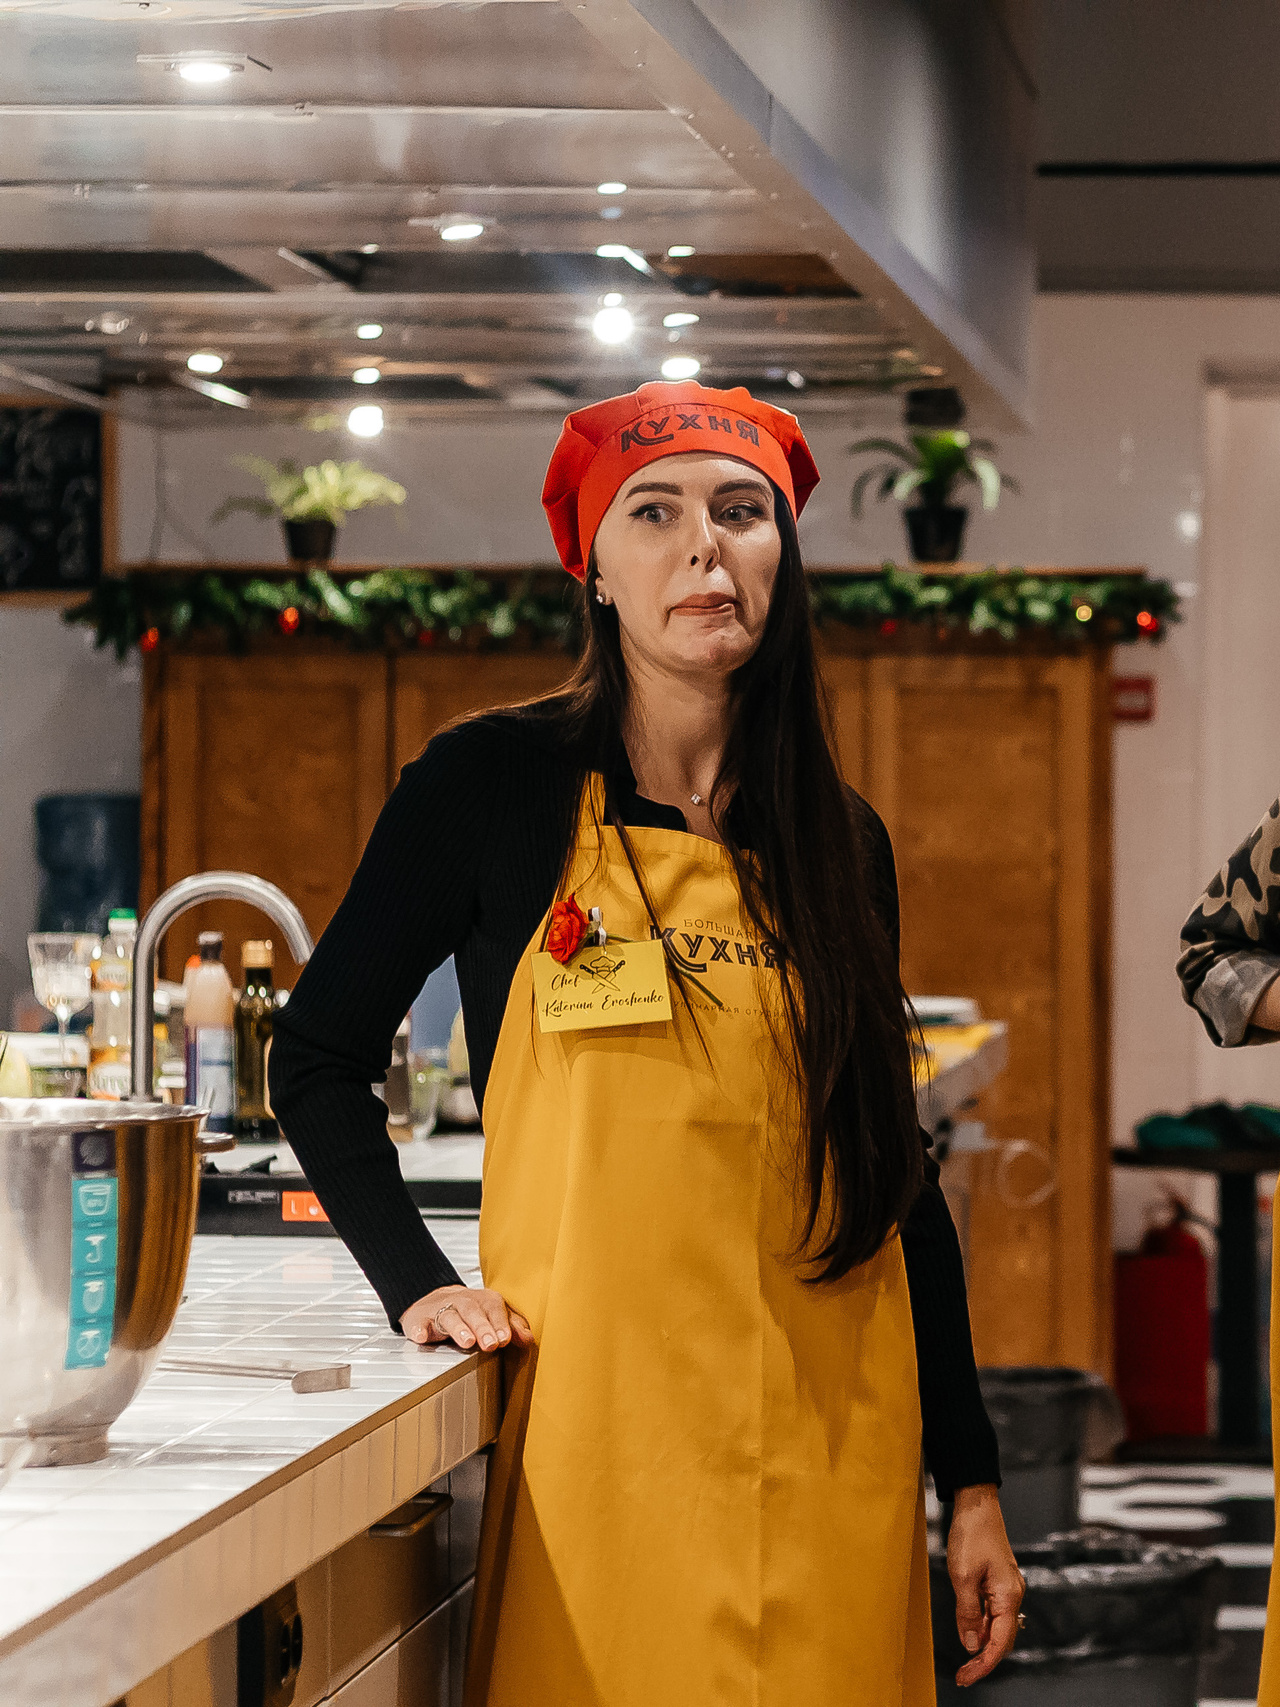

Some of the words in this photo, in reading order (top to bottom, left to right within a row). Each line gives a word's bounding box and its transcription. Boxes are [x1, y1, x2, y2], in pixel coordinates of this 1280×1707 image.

[620, 413, 760, 453] КУХНЯ
[551, 973, 580, 991] Chef
[543, 999, 594, 1018] Katerina
[601, 988, 665, 1011] Eroshenko
[673, 1000, 740, 1015] УЛНАРНАЯ
